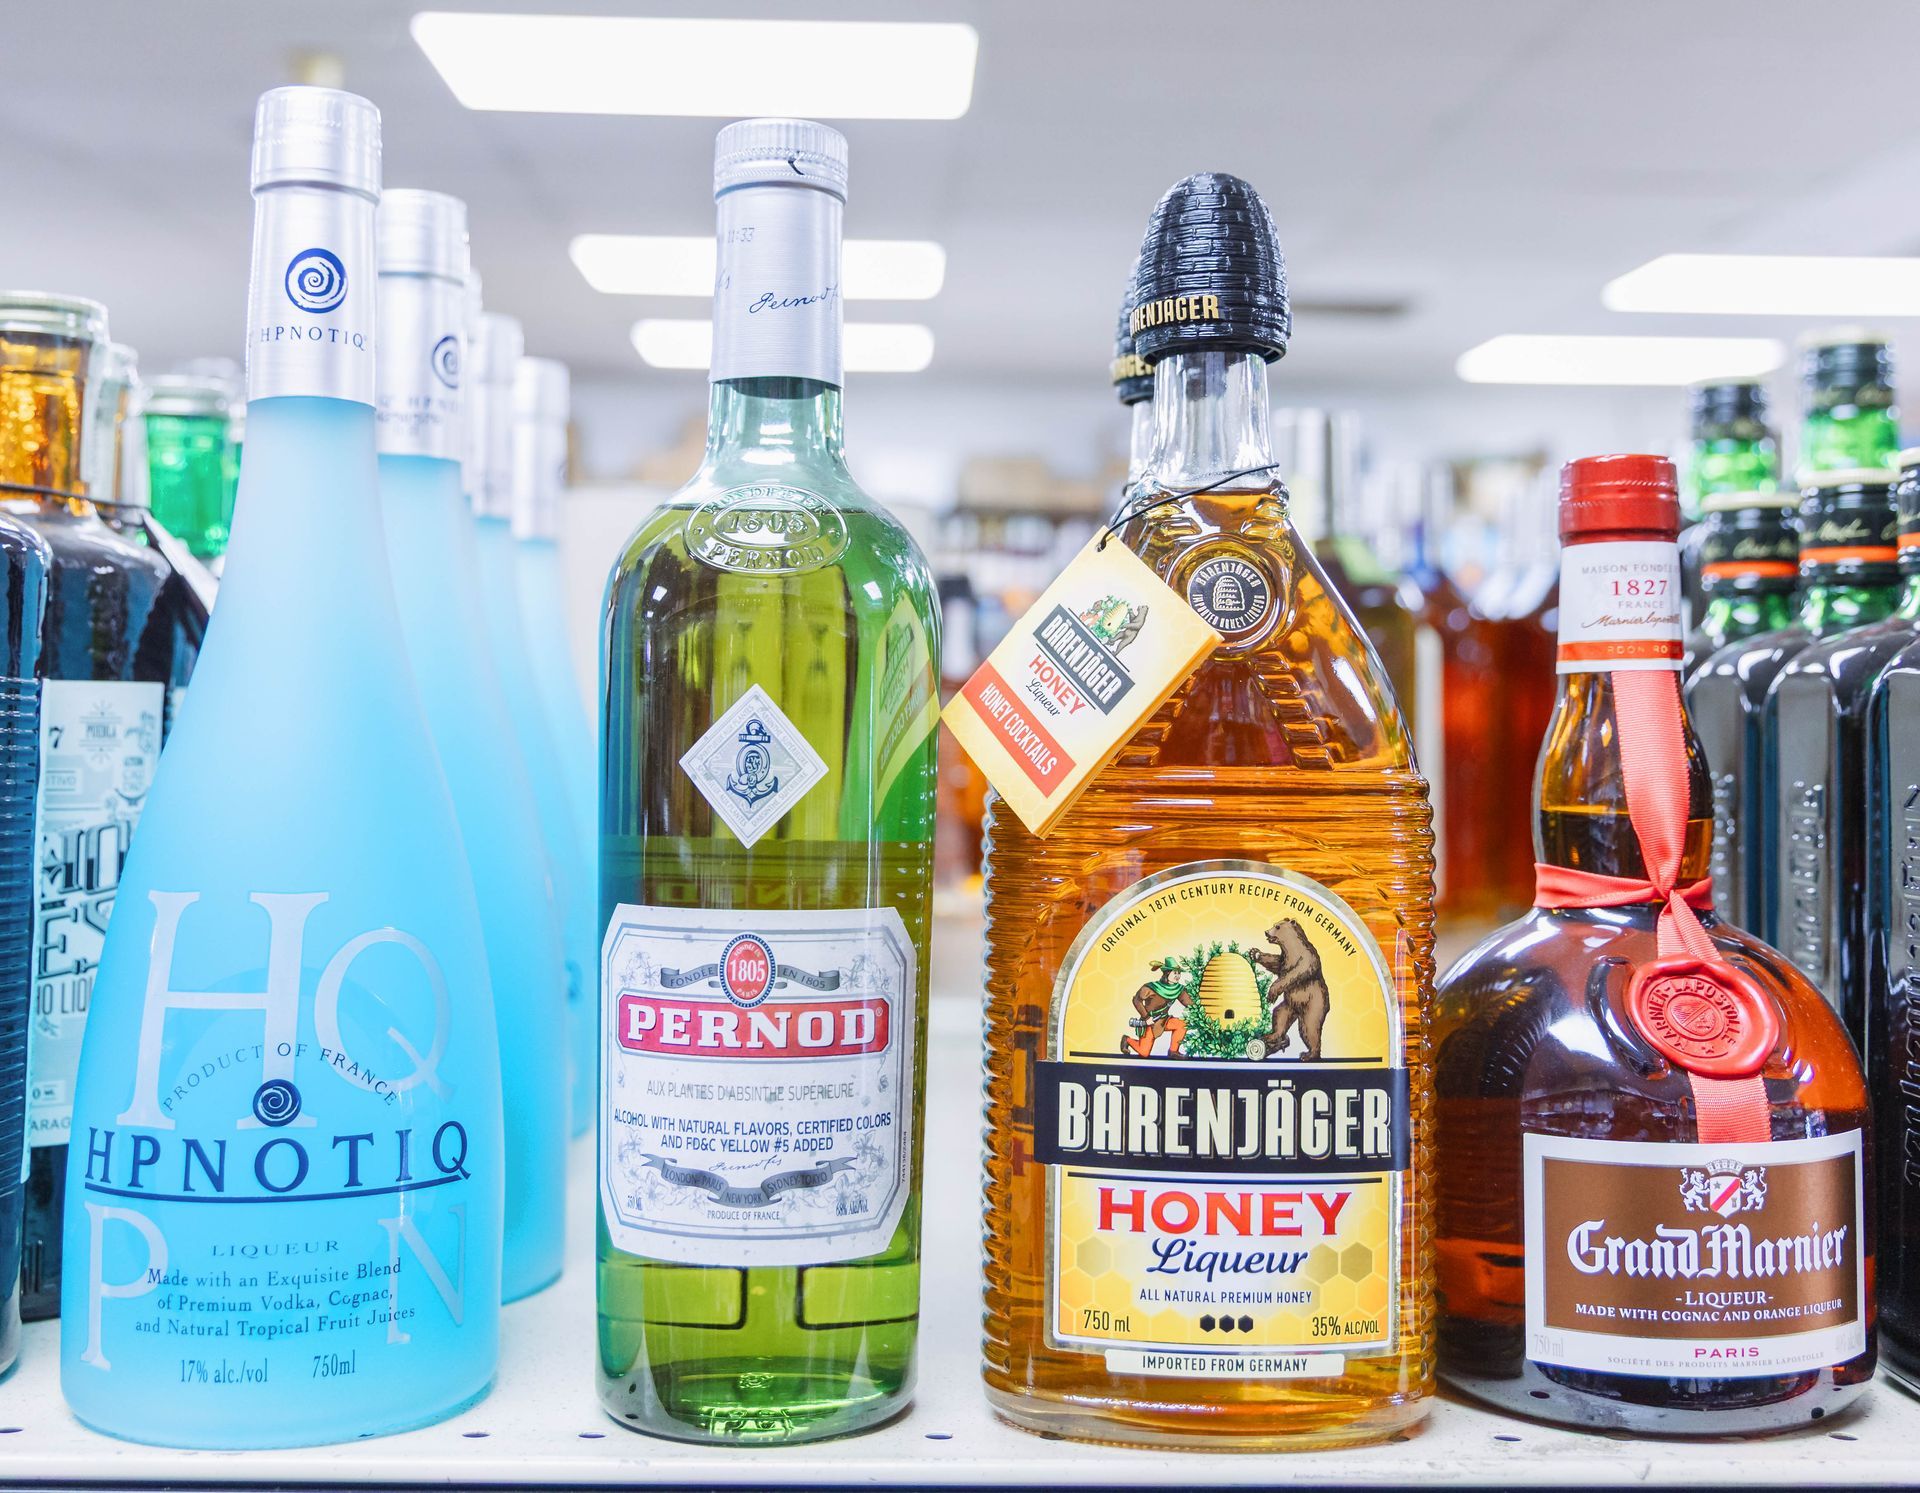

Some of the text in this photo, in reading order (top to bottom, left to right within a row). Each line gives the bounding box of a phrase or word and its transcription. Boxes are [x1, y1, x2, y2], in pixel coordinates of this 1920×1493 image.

[1130, 295, 1219, 336] RENJÄGER
[1611, 579, 1668, 596] 1827
[1618, 600, 1664, 609] FRANCE
[1041, 614, 1122, 704] BÄRENJÄGER
[1026, 677, 1061, 717] Liqueur
[1029, 654, 1087, 716] HONEY
[979, 682, 1058, 776] HONEY COCKTAILS
[1101, 883, 1357, 957] ORIGINAL 18TH CENTURY RECIPE FROM GERMANY
[730, 959, 766, 981] 1805
[783, 967, 798, 979] EN
[800, 973, 826, 989] 1805
[627, 1003, 876, 1049] PERNOD
[163, 1042, 398, 1112] PRODUCT OF FRANCE
[647, 1080, 667, 1095] AUX
[668, 1081, 714, 1099] PLANTES
[614, 1107, 892, 1137] ALCOHOL WITH NATURAL FLAVORS, CERTIFIED COLORS
[1058, 1074, 1392, 1160] BÄRENJÄGER
[85, 1120, 471, 1193] HPNOTIQ
[660, 1136, 834, 1153] AND FD&C YELLOW #5 ADDED
[726, 1192, 762, 1204] NEW YORK
[707, 1210, 780, 1220] PRODUCE OF FRANCE
[1098, 1187, 1352, 1238] HONEY
[212, 1240, 340, 1259] LIQUEUR
[1146, 1237, 1309, 1283] Liqueur
[1567, 1219, 1846, 1279] Grand Marnier
[147, 1257, 402, 1289] Made with an Exquisite Blend
[157, 1286, 393, 1312] of Premium Vodka, Cognac,
[1140, 1289, 1312, 1304] ALL NATURAL PREMIUM HONEY
[135, 1306, 416, 1339] and Natural Tropical Fruit Juices
[1083, 1309, 1130, 1333] 750 ml
[1575, 1298, 1843, 1322] MADE WITH COGNAC AND ORANGE LIQUEUR
[1311, 1316, 1379, 1337] 35% ALC/VOL
[312, 1350, 356, 1378] 750ml
[1142, 1355, 1308, 1373] IMPORTED FROM GERMANY
[1607, 1352, 1825, 1368] SOCIÉTÉ DES PRODUITS MARNIER LAPOSTOLLE
[1695, 1347, 1760, 1358] PARIS
[180, 1358, 269, 1384] 17% alc./vol
